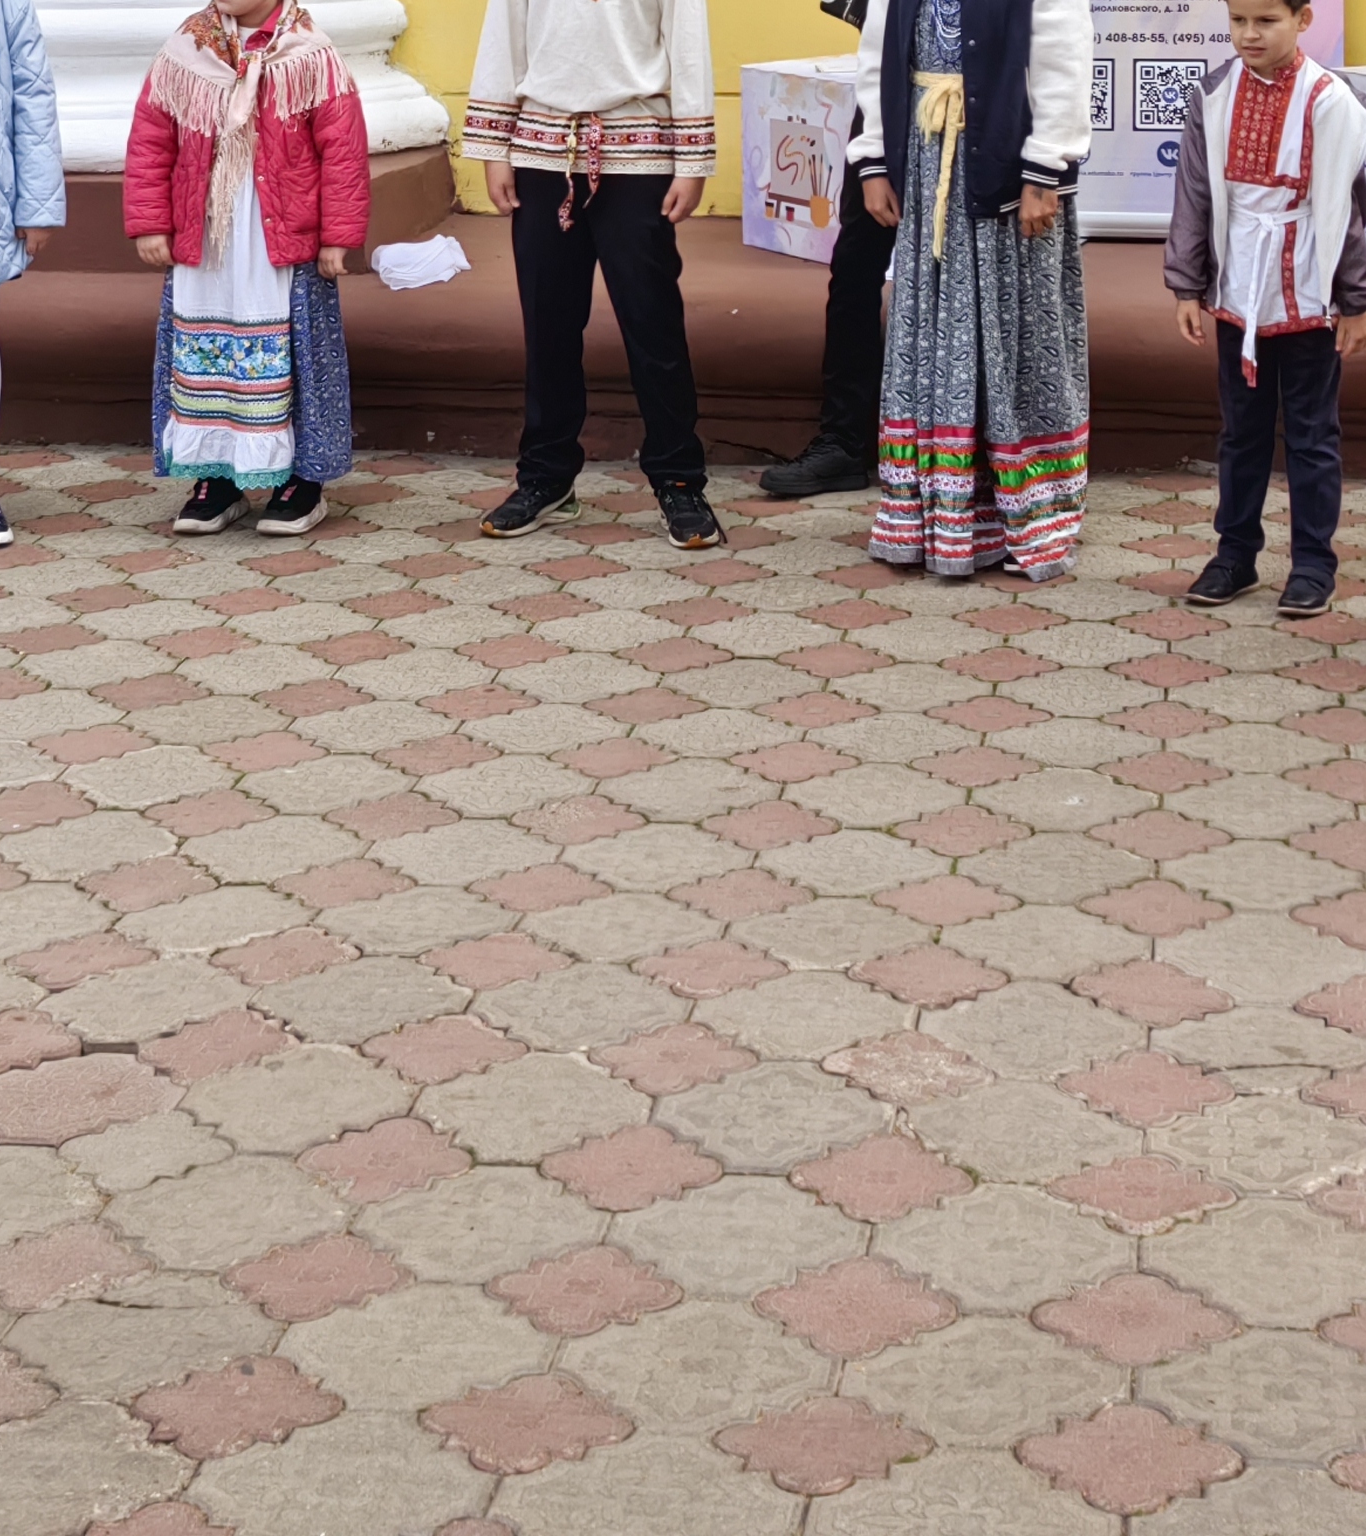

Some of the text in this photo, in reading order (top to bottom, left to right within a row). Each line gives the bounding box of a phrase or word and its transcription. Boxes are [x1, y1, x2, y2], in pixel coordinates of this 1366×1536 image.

[1177, 4, 1190, 13] 10
[1173, 33, 1205, 45] (495)
[1209, 33, 1232, 43] 408
